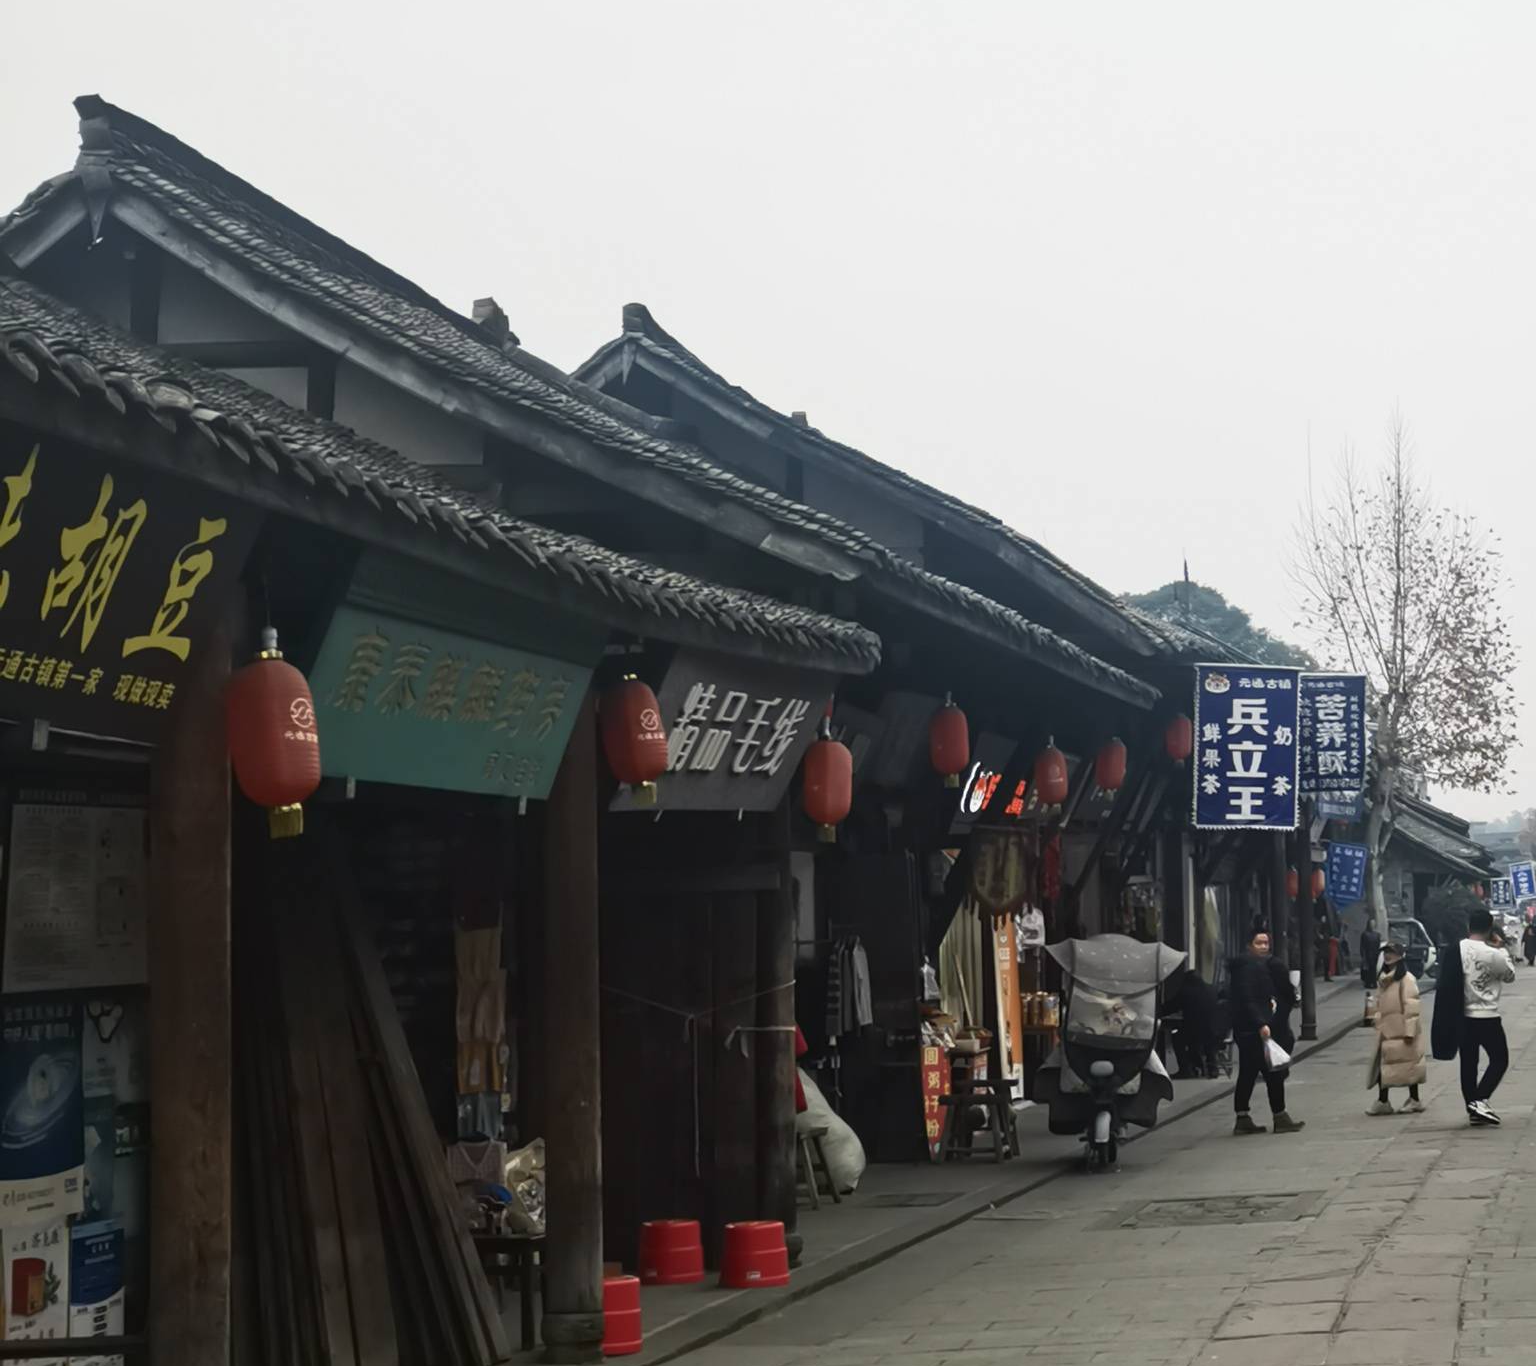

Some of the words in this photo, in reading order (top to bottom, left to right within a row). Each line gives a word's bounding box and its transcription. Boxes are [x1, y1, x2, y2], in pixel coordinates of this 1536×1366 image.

[113, 673, 176, 710] 现做现卖
[667, 682, 811, 776] 精品毛线
[1201, 722, 1222, 795] 鲜果茶
[1225, 698, 1269, 820] 兵立王
[1271, 725, 1293, 796] 奶茶
[1314, 693, 1347, 775] 苦荞酥
